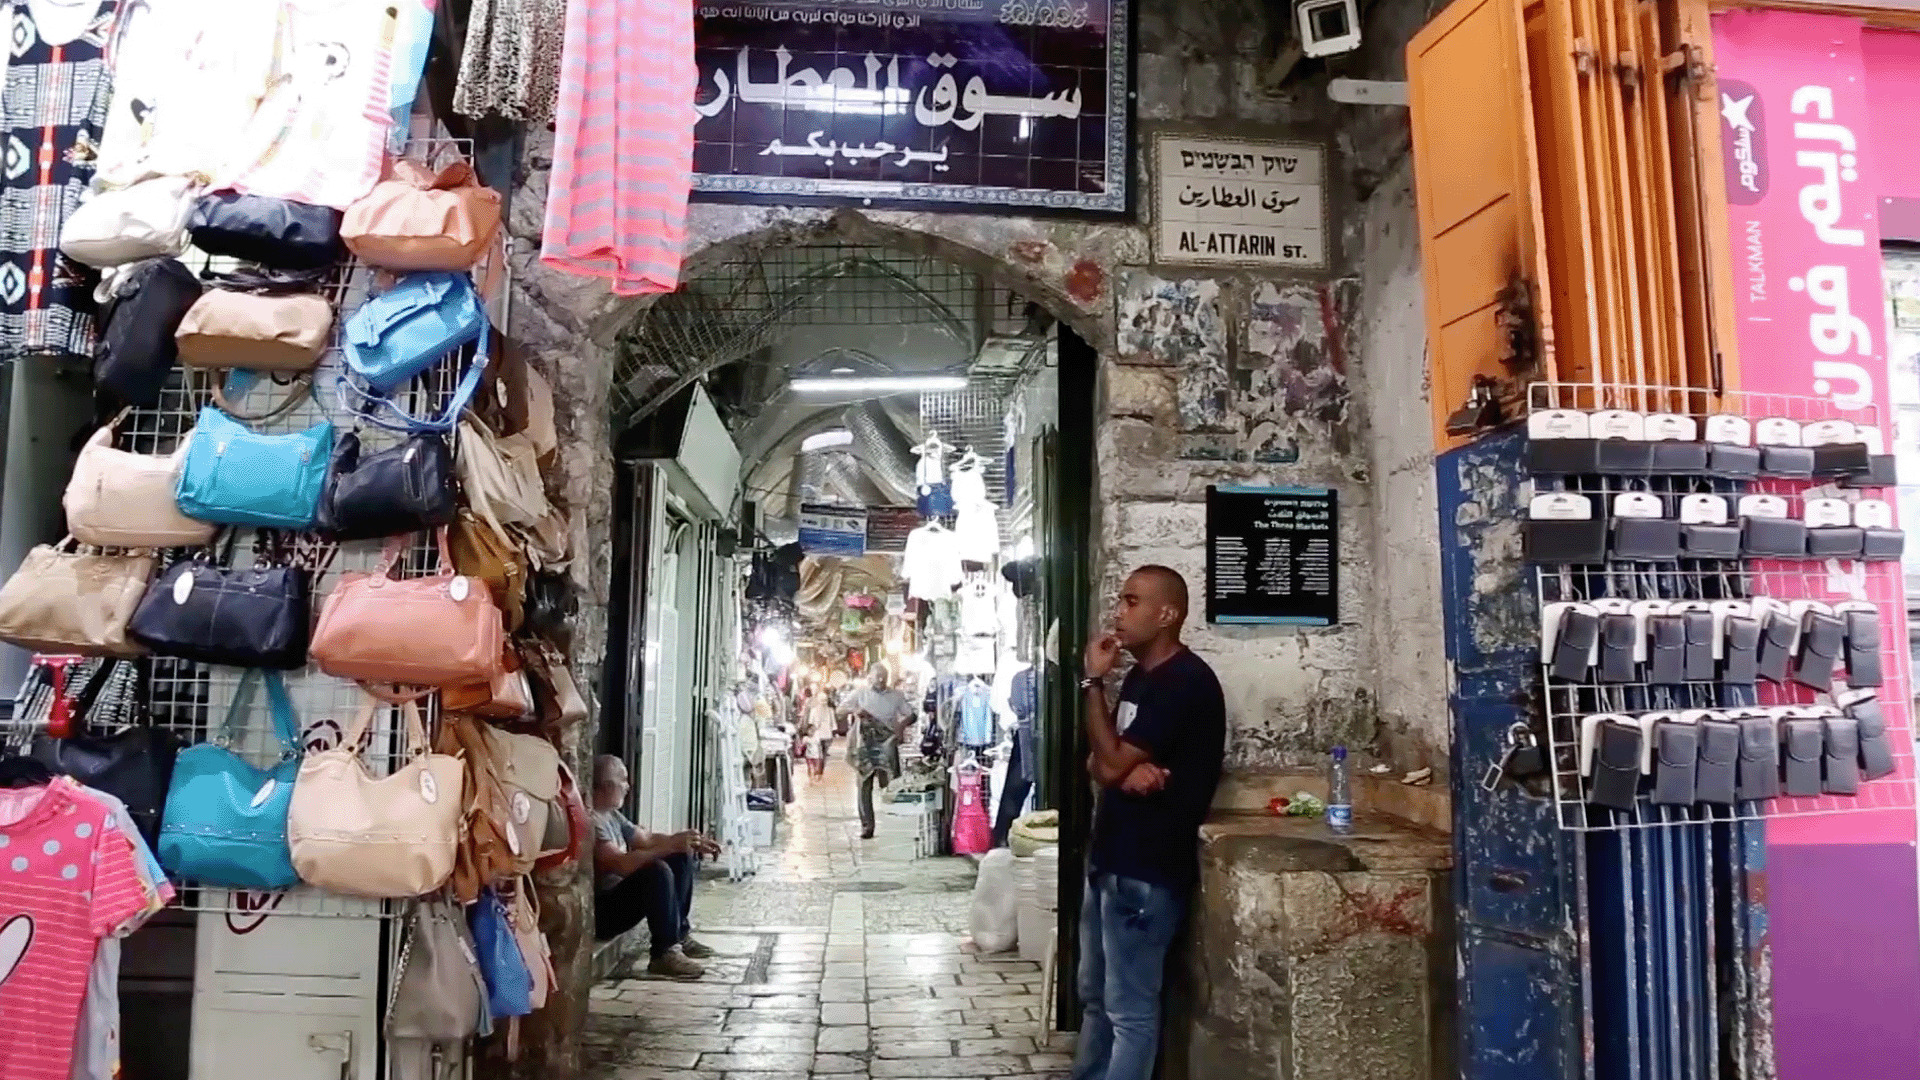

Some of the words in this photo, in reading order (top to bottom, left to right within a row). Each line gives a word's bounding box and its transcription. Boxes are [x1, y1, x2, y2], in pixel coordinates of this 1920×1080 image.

[693, 44, 901, 117] العطار
[913, 52, 1083, 131] سوق
[757, 130, 837, 167] بكم
[841, 140, 950, 172] يرحب
[1261, 154, 1298, 176] שוק
[1790, 84, 1866, 247] دريم
[1178, 184, 1256, 208] العطارين
[1261, 190, 1300, 214] سوق
[1178, 231, 1276, 257] AL-ATTARIN
[1282, 245, 1308, 259] ST.
[1746, 219, 1767, 304] TALKMAN
[1787, 264, 1873, 412] فون
[1253, 520, 1270, 529] The
